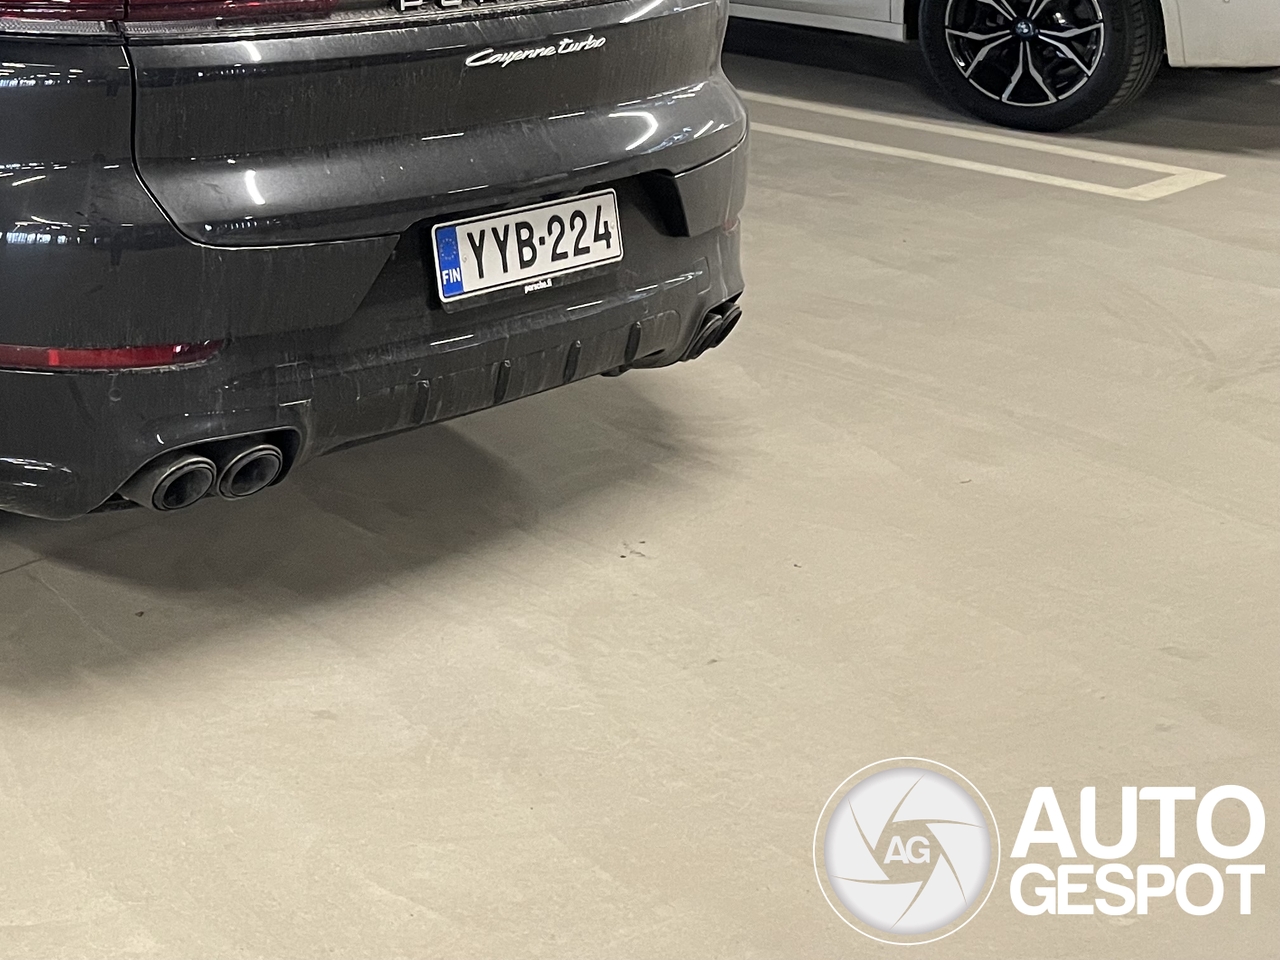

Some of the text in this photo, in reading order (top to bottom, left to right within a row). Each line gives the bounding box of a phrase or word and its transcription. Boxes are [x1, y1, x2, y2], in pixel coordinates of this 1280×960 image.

[465, 34, 607, 68] Cayenne turbo
[466, 205, 612, 280] YYB-224
[442, 267, 462, 286] FIN
[524, 278, 553, 295] porsche.fi
